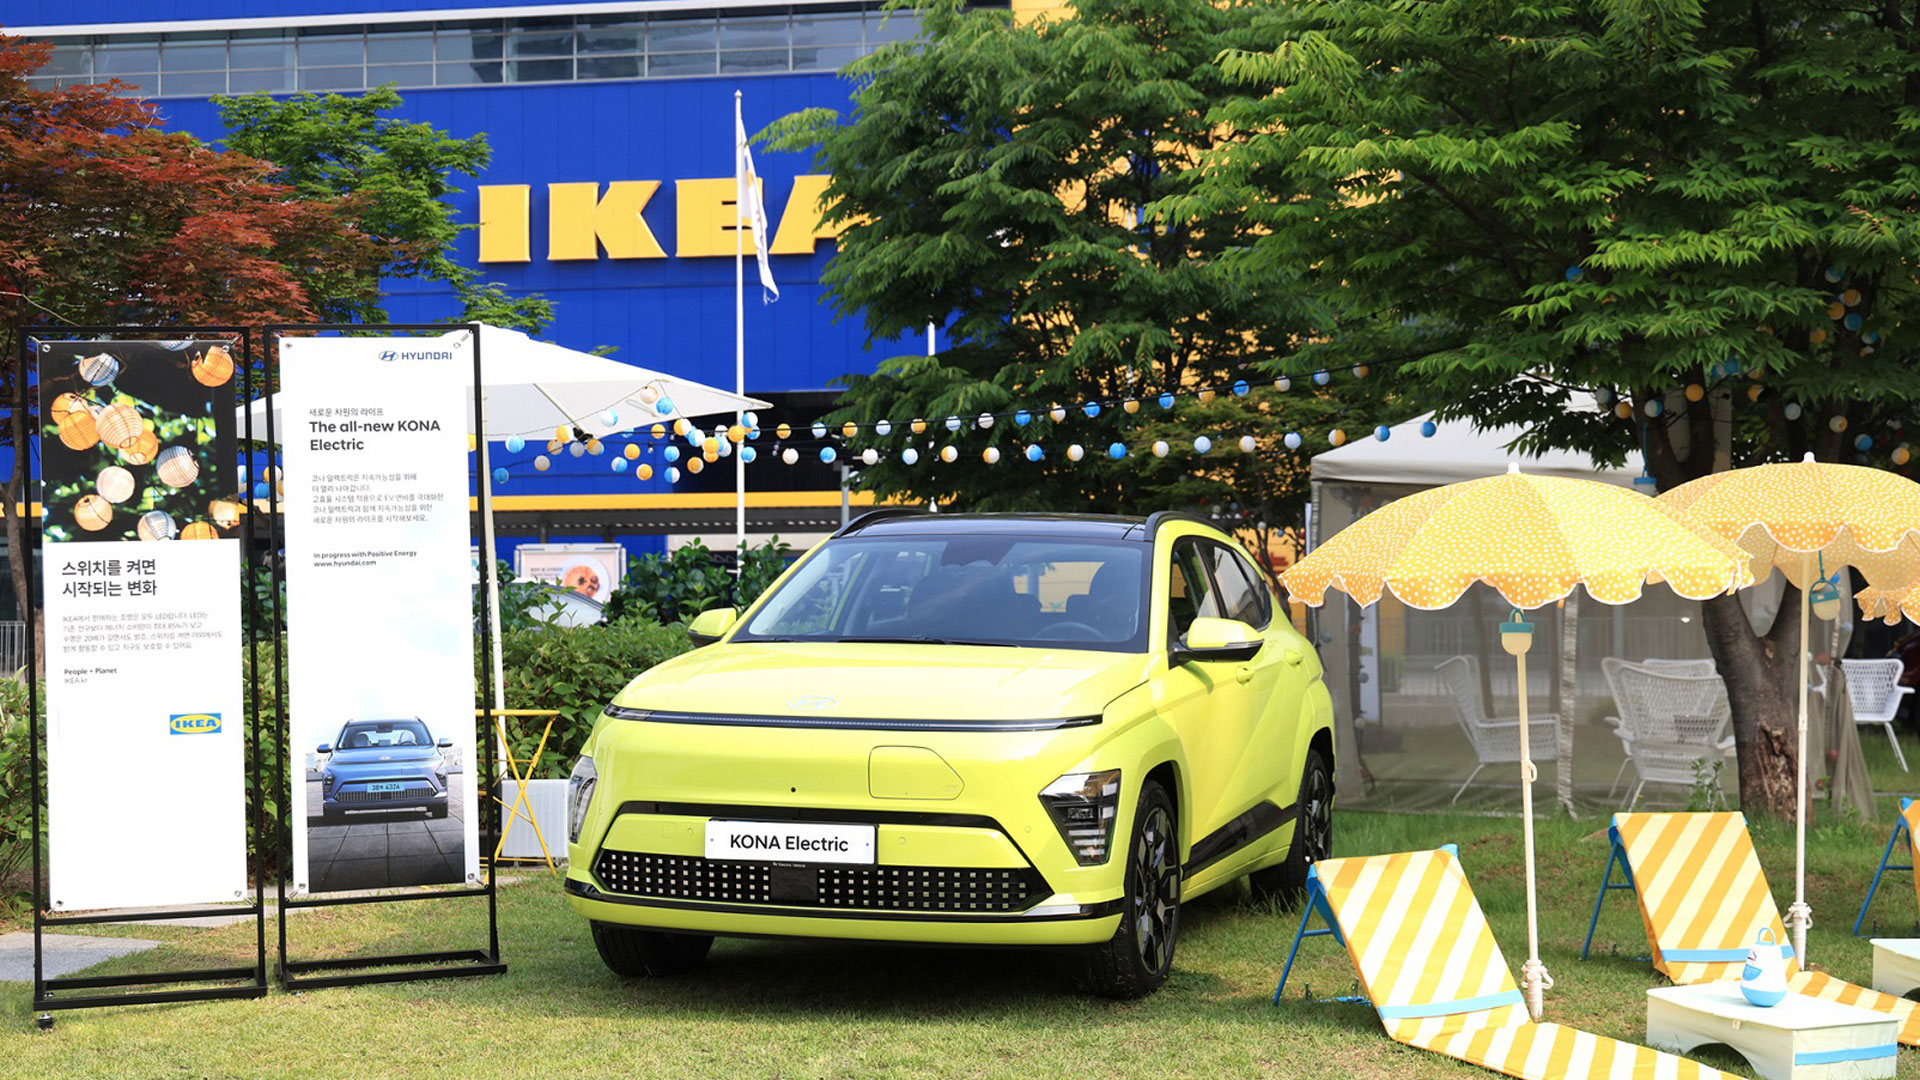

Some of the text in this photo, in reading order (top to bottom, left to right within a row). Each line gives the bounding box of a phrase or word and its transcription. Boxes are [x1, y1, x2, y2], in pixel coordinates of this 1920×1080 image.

[478, 174, 880, 263] IKEA
[401, 352, 453, 360] HYUNDAI
[309, 407, 384, 417] 새로운 차원의 라이프
[309, 420, 441, 432] The all-new KONA
[310, 438, 364, 451] Electric
[394, 550, 417, 558] Energy
[62, 559, 156, 576] 스위치를 켜면
[314, 560, 376, 568] www.hyundai.com
[62, 580, 157, 598] 시작되는 변화
[64, 668, 88, 676] People
[175, 719, 217, 728] IKEA
[730, 834, 848, 852] KONA Electric
